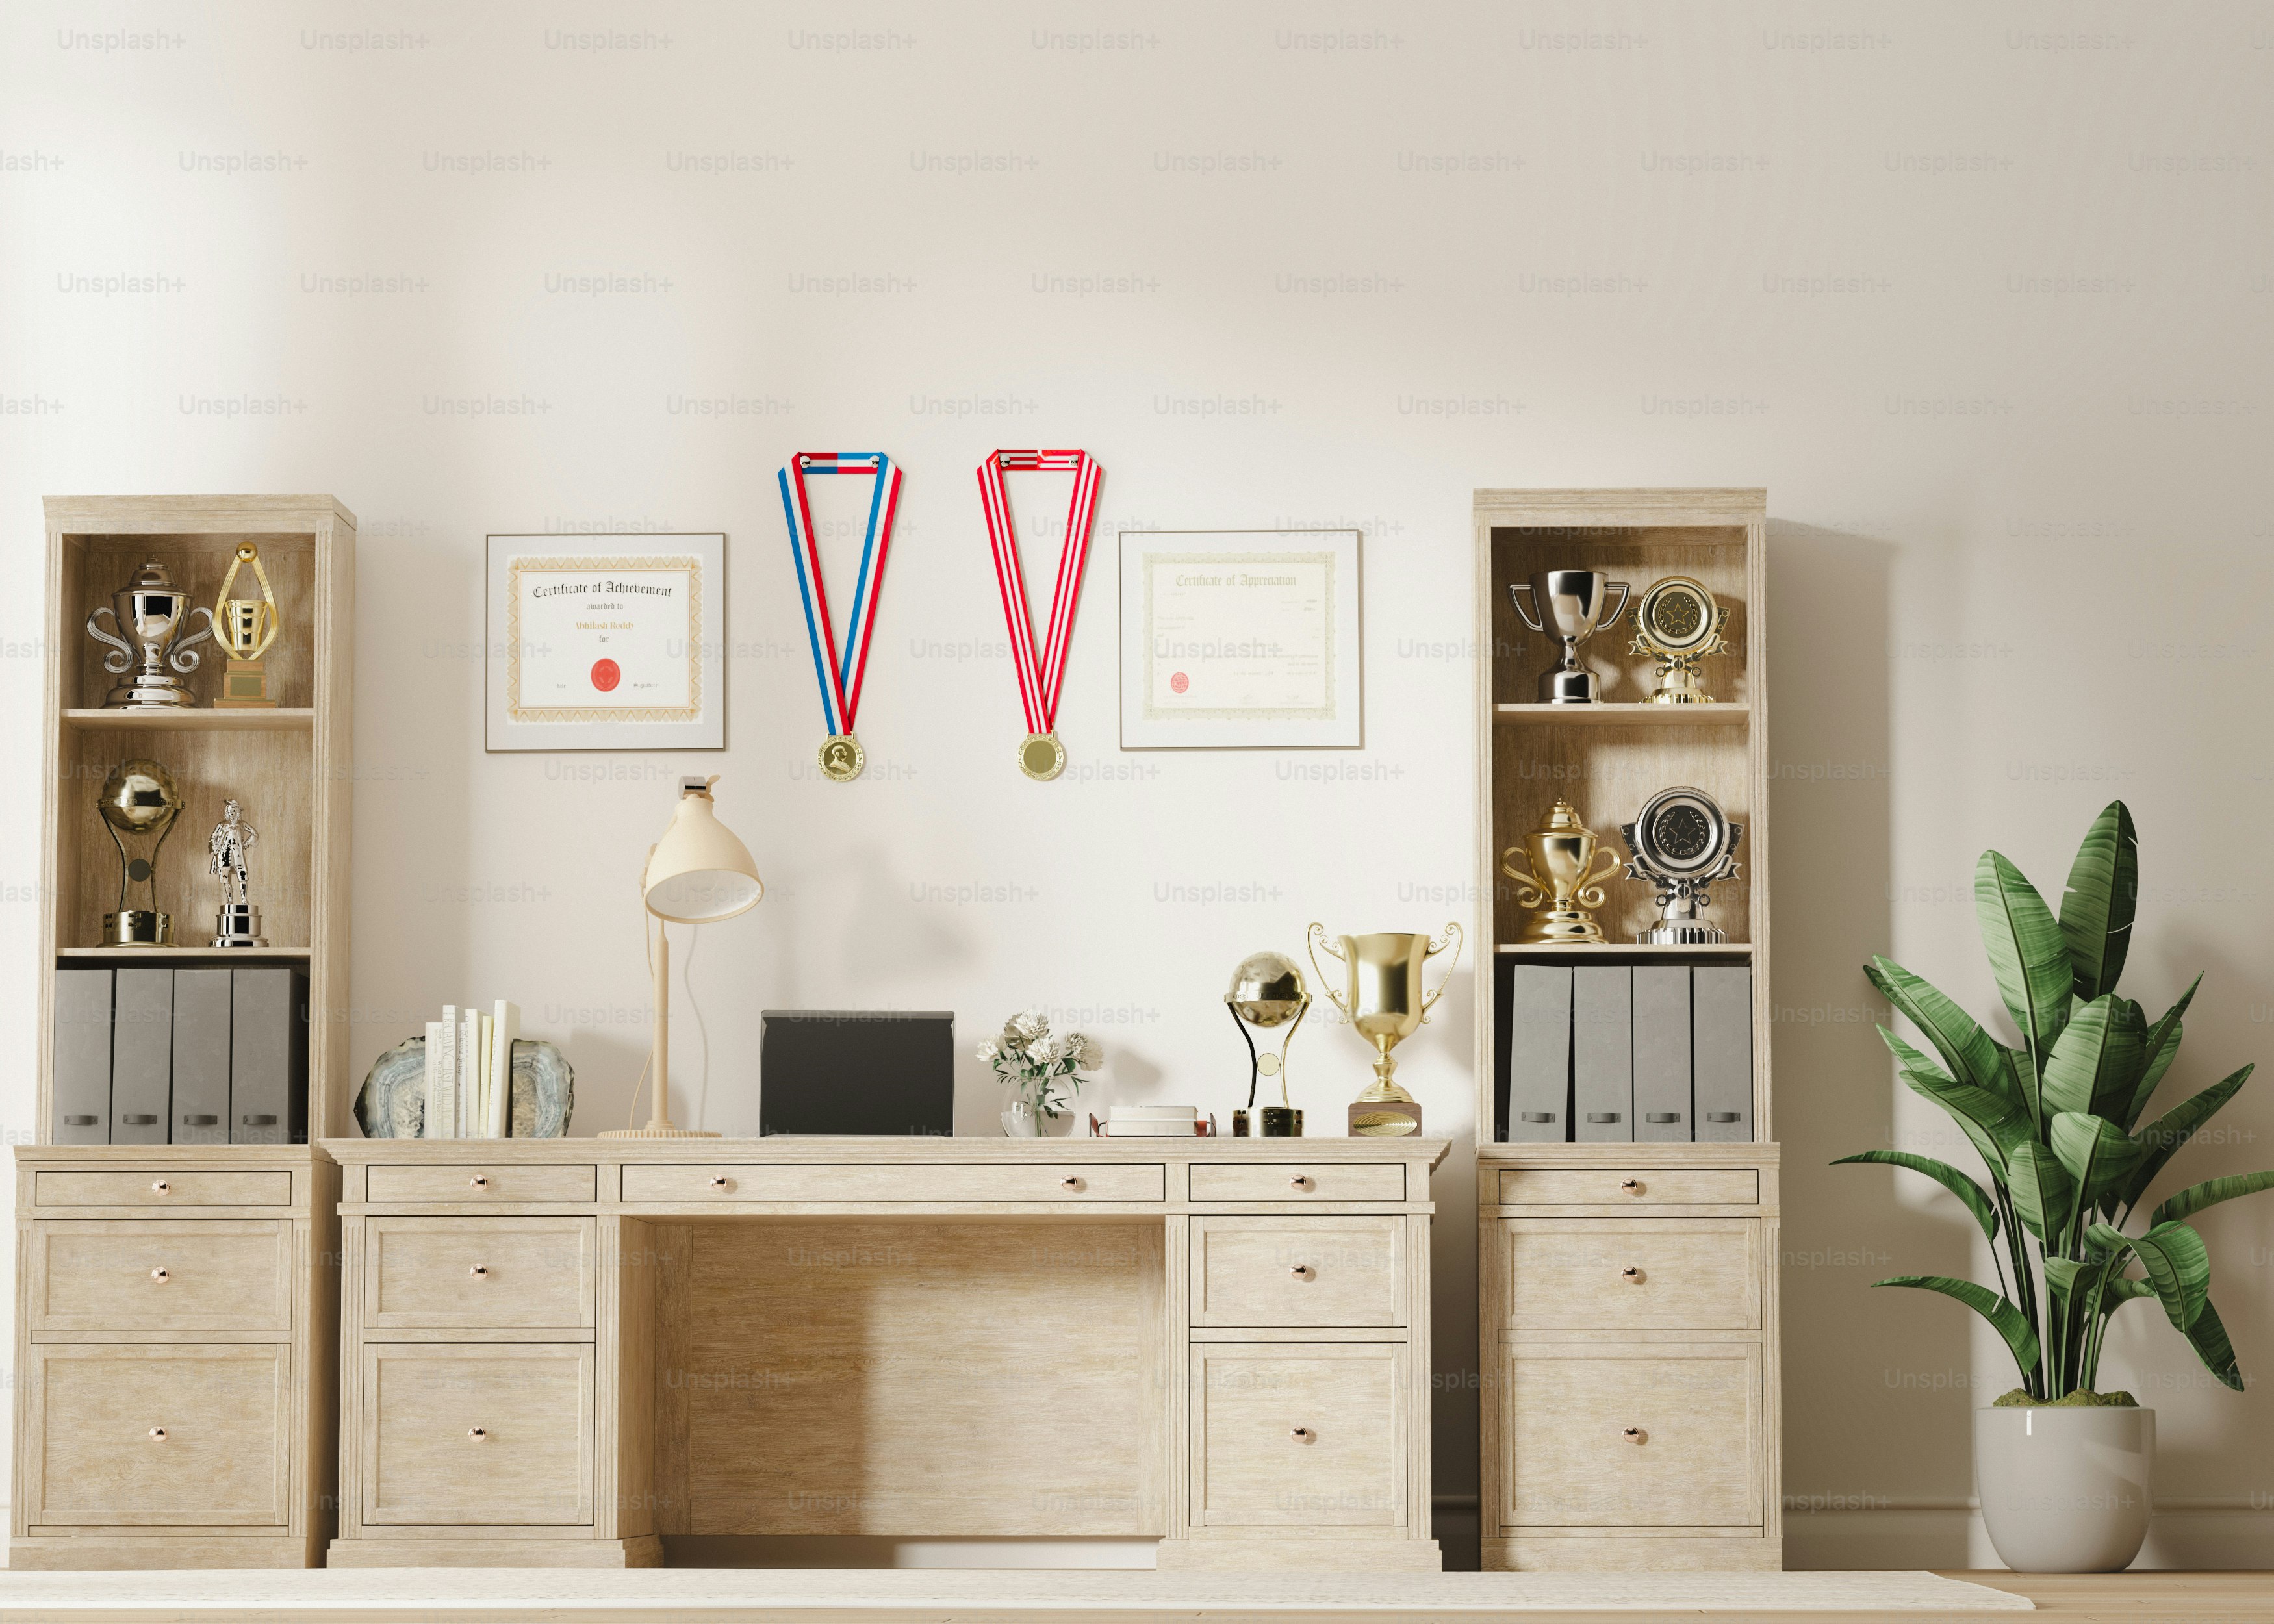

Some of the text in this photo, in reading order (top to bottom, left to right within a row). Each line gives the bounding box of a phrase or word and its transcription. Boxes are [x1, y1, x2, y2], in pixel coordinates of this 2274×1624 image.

[1176, 574, 1296, 587] Certificate of Appreciation
[533, 581, 672, 598] Certificate of Achievement
[610, 622, 634, 630] Reddy
